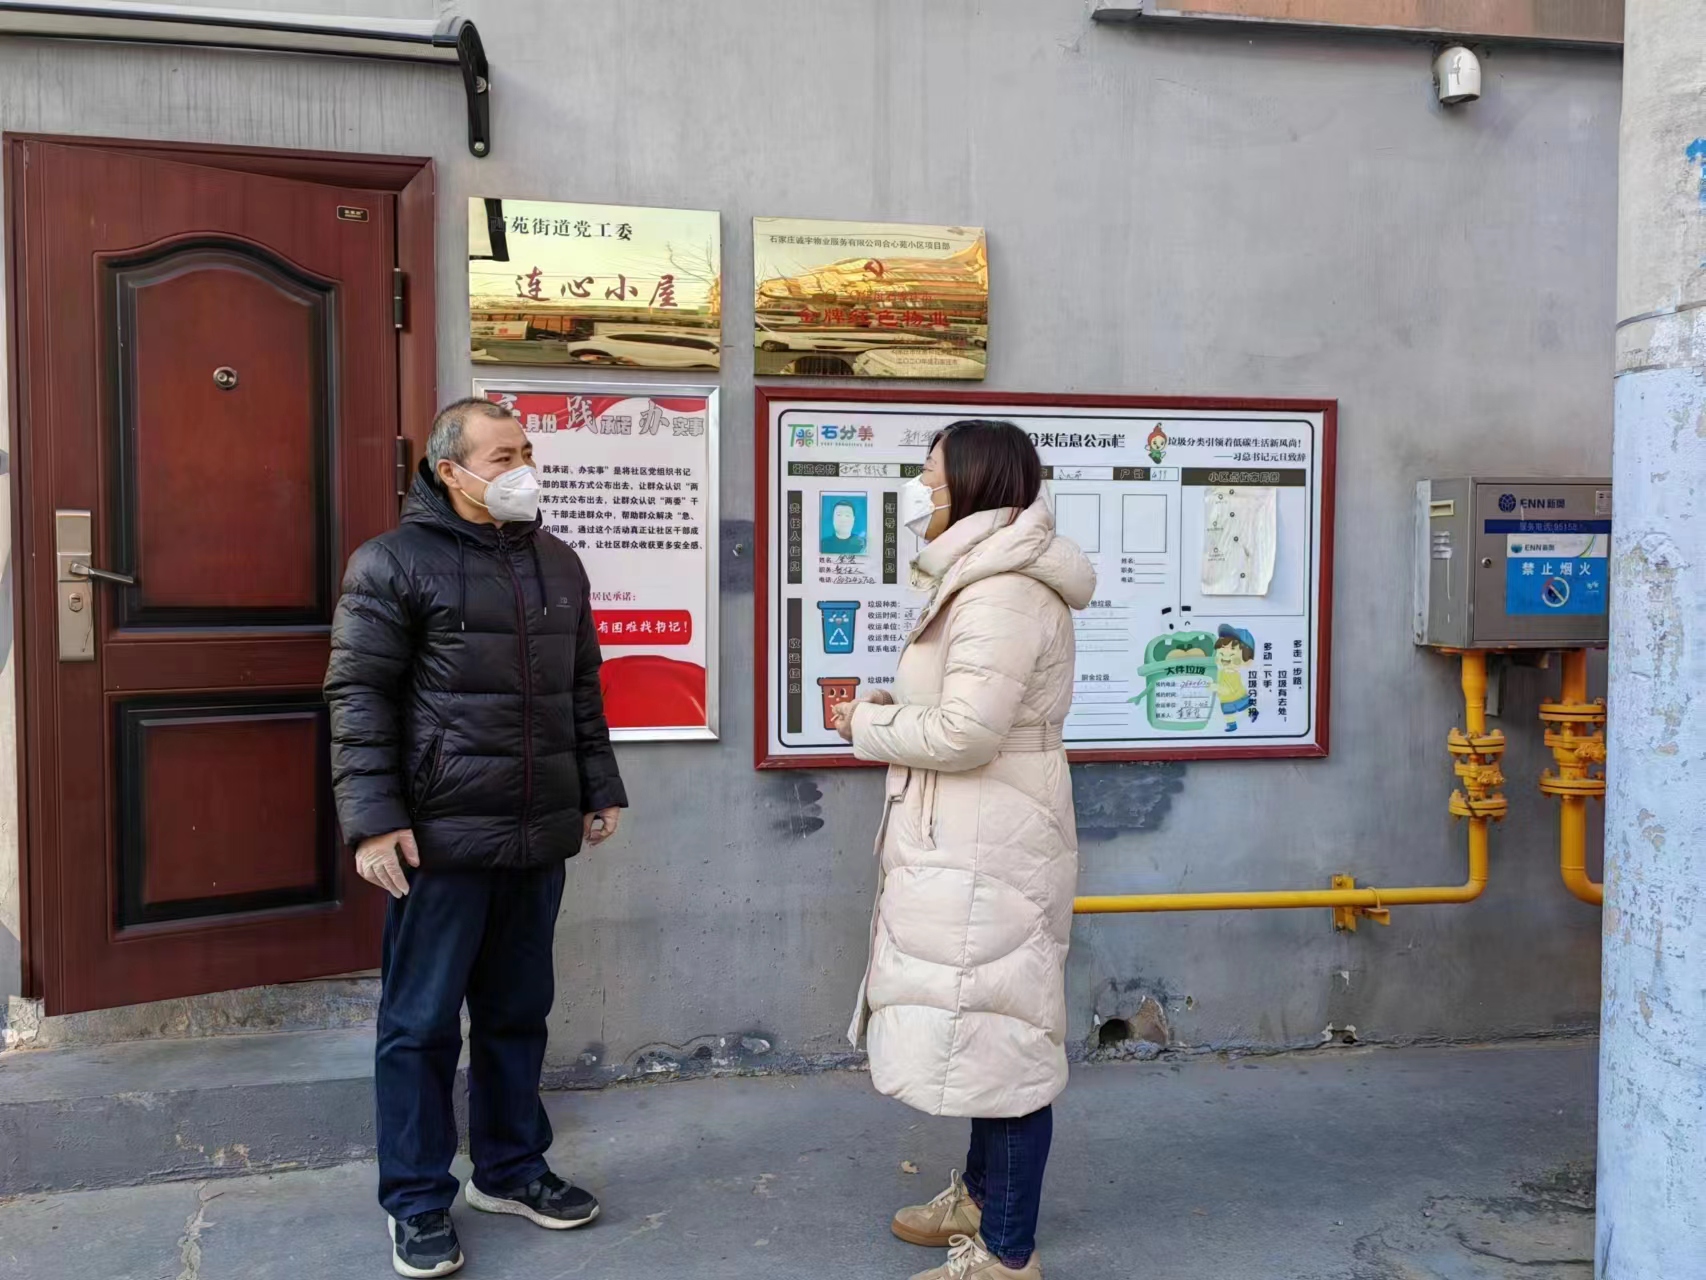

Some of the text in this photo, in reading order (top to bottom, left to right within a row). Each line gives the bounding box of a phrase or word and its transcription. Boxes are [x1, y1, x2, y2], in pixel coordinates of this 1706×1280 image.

[515, 265, 679, 308] 连心小屋
[821, 425, 875, 441] 石分美
[1168, 437, 1302, 448] 垃圾分类引领着低碳生活新风尚！
[1521, 562, 1592, 576] 禁止烟火
[598, 620, 688, 634] 有困难找书记！
[1164, 665, 1206, 676] 大件垃圾
